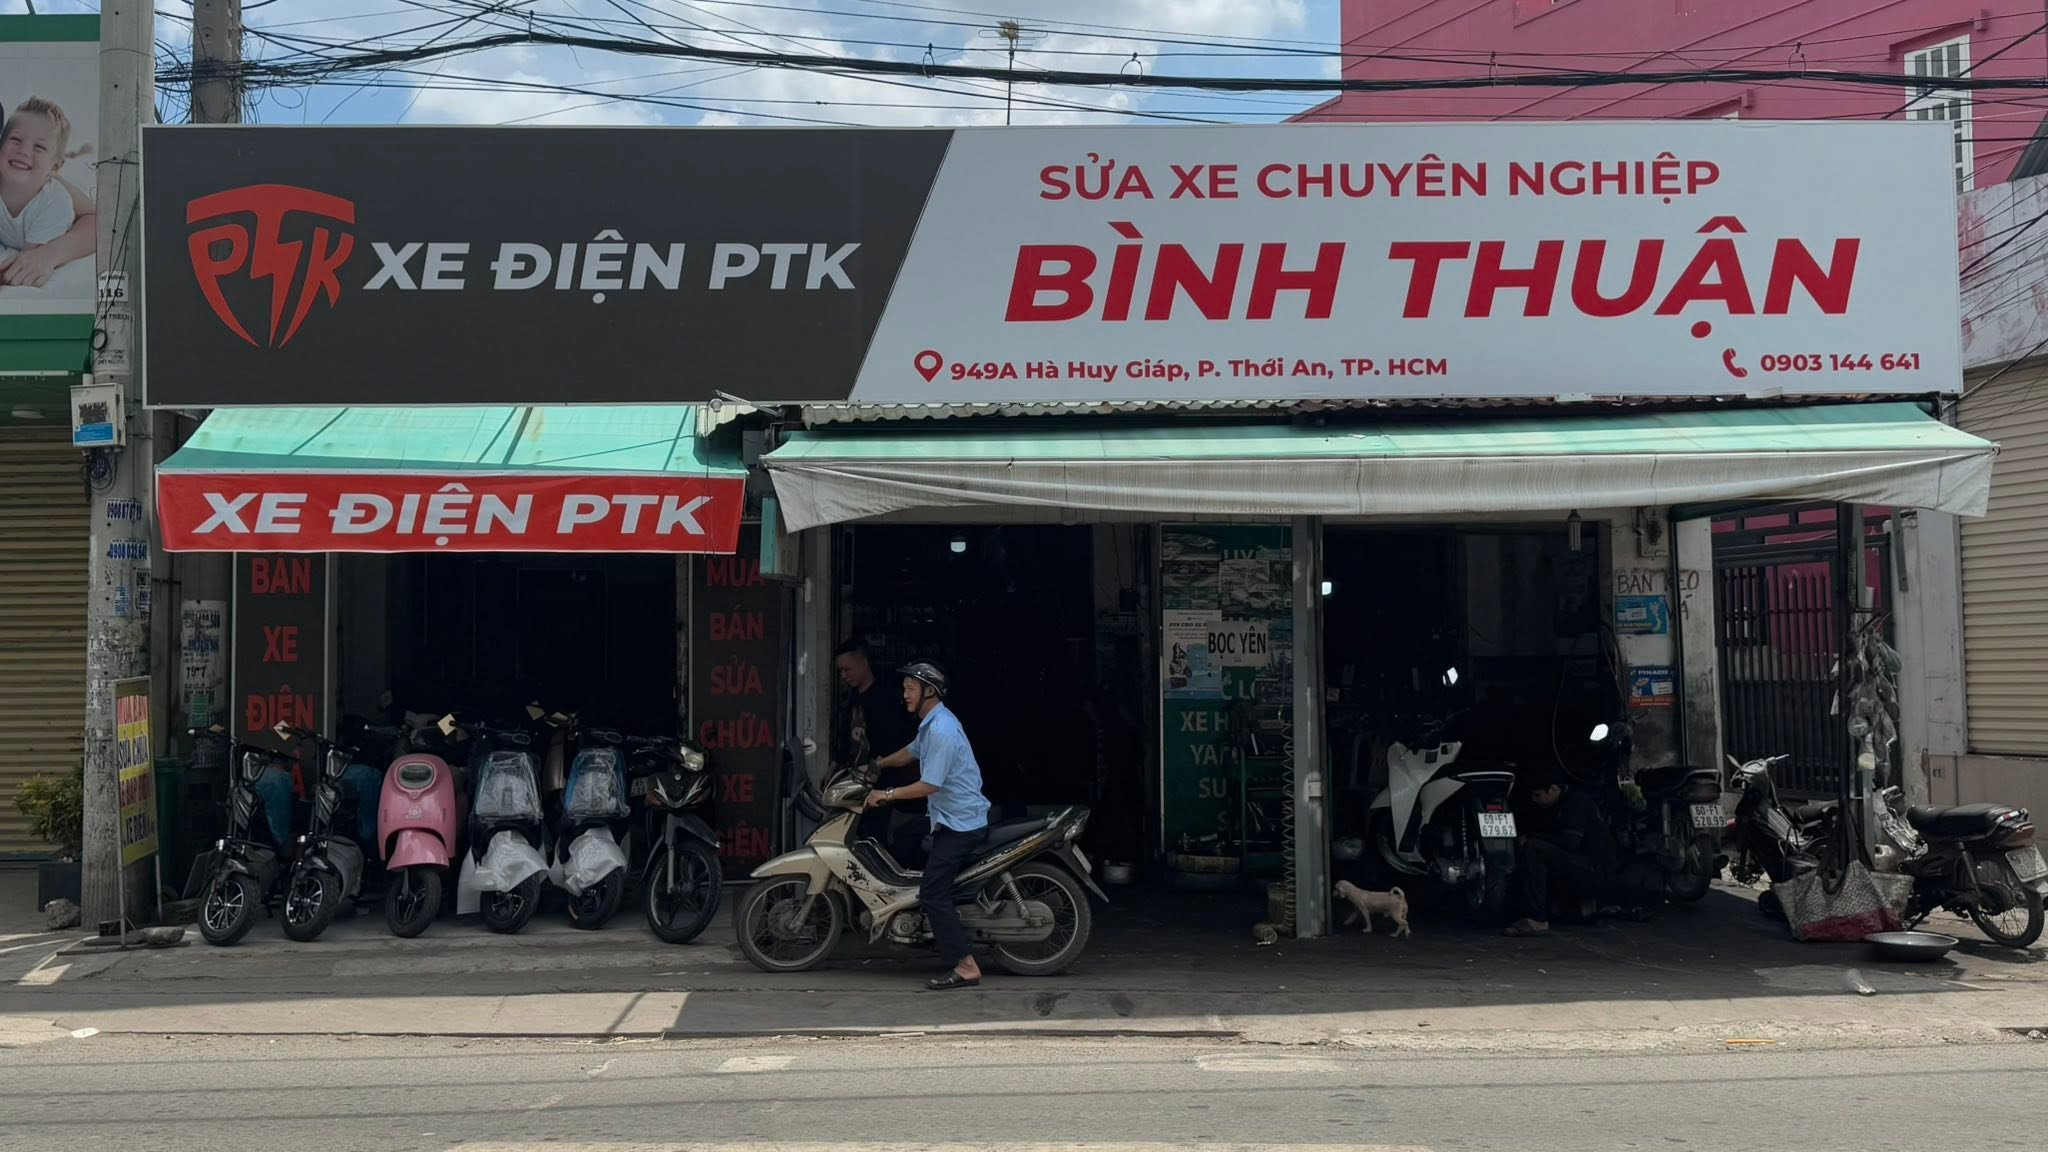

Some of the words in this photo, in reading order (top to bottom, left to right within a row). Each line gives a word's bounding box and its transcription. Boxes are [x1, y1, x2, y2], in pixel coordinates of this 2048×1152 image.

[1040, 153, 1153, 201] SỬA
[1171, 164, 1239, 200] XE
[1257, 153, 1488, 199] CHUYÊN
[1508, 152, 1721, 204] NGHIỆP
[363, 242, 470, 291] XE
[490, 229, 686, 304] ĐIỆN
[708, 243, 861, 291] PTK
[1004, 220, 1347, 323] BÌNH
[1388, 215, 1861, 339] THUẬN
[950, 362, 1018, 381] 949A
[1025, 361, 1060, 380] Hà
[1067, 362, 1118, 383] Huy
[1126, 359, 1191, 383] Giáp,
[1198, 360, 1222, 378] P.
[1229, 358, 1285, 378] Thới
[1292, 360, 1335, 379] An,
[1342, 358, 1381, 377] TP.
[1388, 358, 1449, 377] HCM
[1760, 354, 1823, 373] 0903
[1830, 355, 1873, 373] 144
[1880, 353, 1921, 372] 641
[193, 493, 307, 534] XE
[329, 483, 533, 546] ĐIỆN
[556, 494, 714, 535] PTK
[706, 559, 765, 588] MUA
[709, 604, 766, 641] BÁN
[262, 625, 300, 662] XE
[1208, 632, 1236, 659] BỌC
[1239, 626, 1267, 654] YÊN
[710, 654, 763, 695] SỬA
[700, 712, 775, 751] CHỮA
[721, 775, 754, 803] XE
